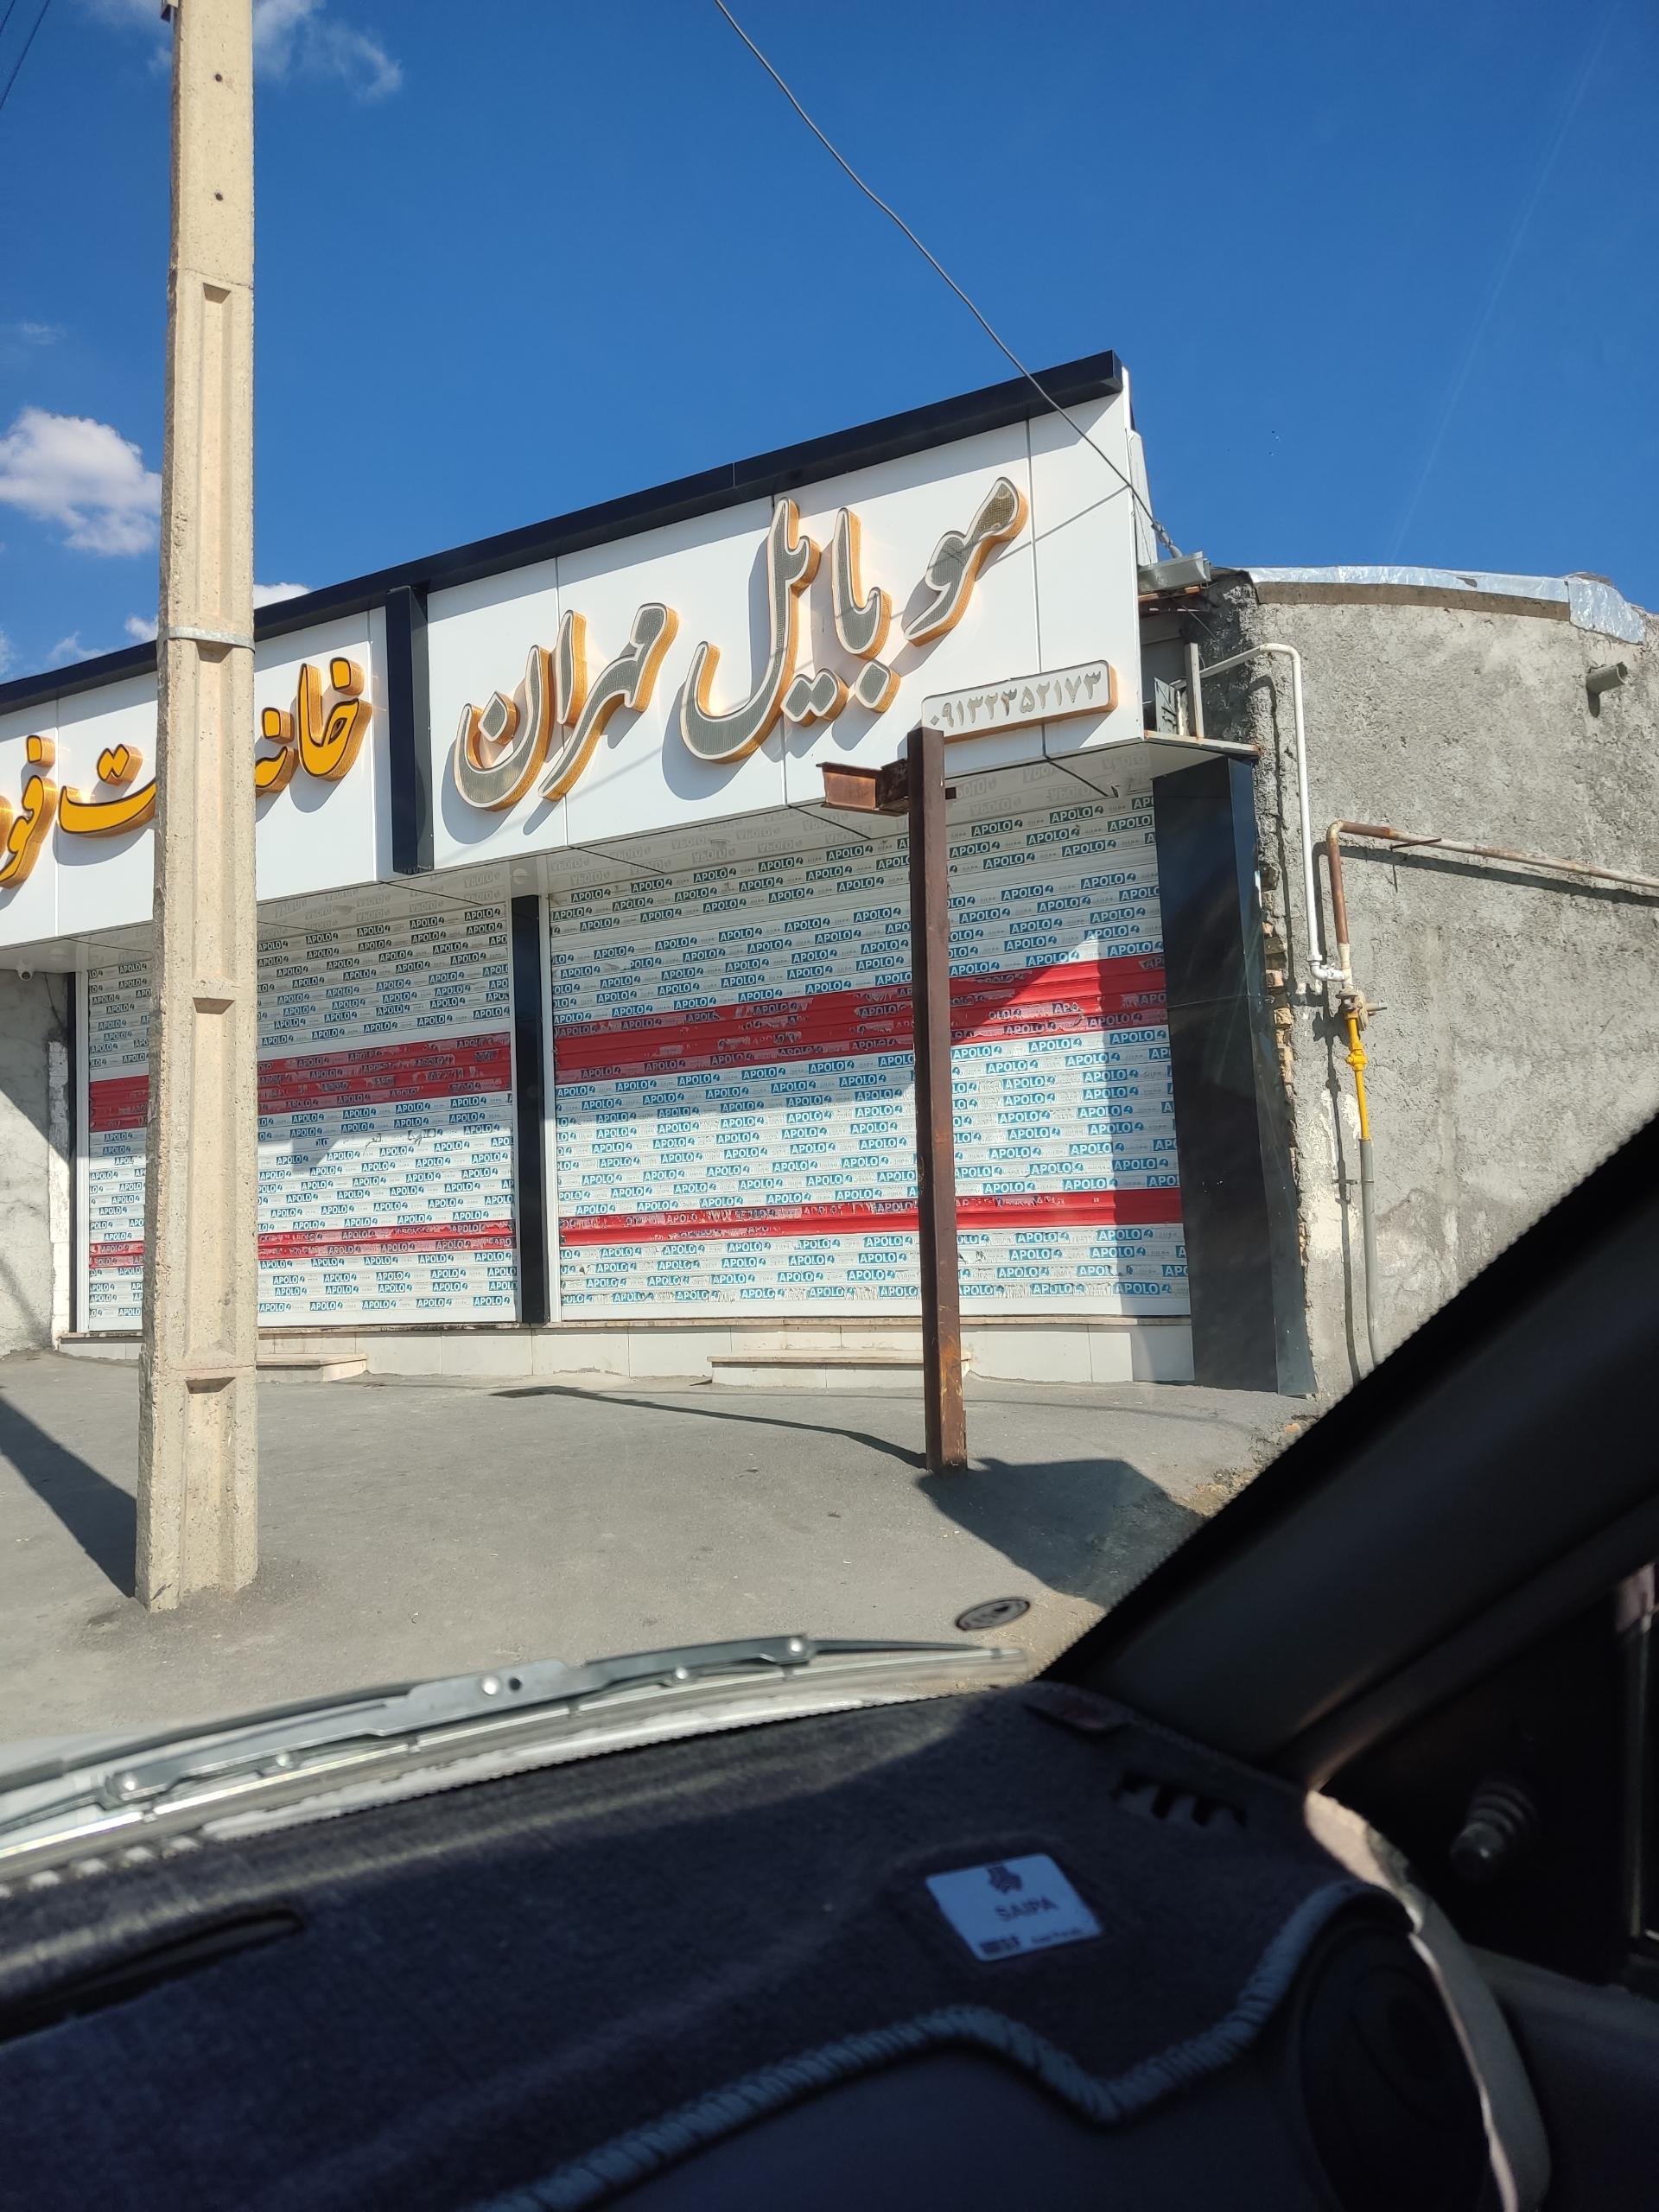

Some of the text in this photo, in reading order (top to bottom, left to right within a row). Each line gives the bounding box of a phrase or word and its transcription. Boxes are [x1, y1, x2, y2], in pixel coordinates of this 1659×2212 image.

[454, 477, 1028, 810] موبایل مهران
[929, 670, 1102, 728] ۰۹۱۳۲۳۵۲۱۷۳
[572, 806, 1092, 902] APOLO APOLO APOLO APOLO APOLO APOLO APOLO
[613, 898, 644, 911] APOLO
[675, 887, 708, 901] APOLO
[740, 877, 773, 891] APOLO
[806, 866, 842, 880] APOLO
[950, 842, 989, 857] APOLO
[1027, 829, 1068, 844] APOLO
[581, 840, 1105, 931] APOLO APOLO APOLO APOLO APOLO APOLO APOLO
[306, 908, 493, 944] APOLO APOLO APOLO APOLO
[594, 873, 1124, 958] APOLO APOLO APOLO APOLO APOLO APOLO APOLO
[307, 923, 494, 959] APOLO APOLO APOLO APOLO
[561, 897, 1079, 978] APOLO APOLO APOLO APOLO APOLO APOLO
[601, 907, 1134, 988] APOLO APOLO APOLO APOLO APOLO APOLO APOLO
[292, 952, 478, 988] APOLO APOLO APOLO APOLO
[597, 925, 1128, 1003] APOLO APOLO APOLO APOLO APOLO APOLO APOLO
[613, 941, 1152, 1017] APOLO APOLO APOLO APOLO APOLO APOLO APOLO
[92, 994, 113, 1005] APOLO
[106, 1003, 128, 1014] APOLO
[283, 985, 462, 1016] APOLO APOLO APOLO APOLO
[99, 1020, 120, 1030] APOLO
[104, 1031, 125, 1041] APOLO
[262, 1007, 501, 1046] APOLO APOLO APOLO APOLO APOLO
[123, 1052, 144, 1063] APOLO
[616, 1080, 647, 1091] APOLO
[677, 1074, 711, 1085] APOLO
[742, 1067, 776, 1079] APOLO
[809, 1060, 844, 1073] APOLO
[1028, 1038, 1071, 1052] APOLO
[1109, 1030, 1154, 1044] APOLO
[582, 1052, 1109, 1109] APOLO APOLO APOLO APOLO APOLO APOLO APOLO
[290, 1112, 477, 1137] APOLO APOLO APOLO APOLO
[292, 1096, 479, 1122] APOLO APOLO APOLO APOLO
[596, 1086, 1127, 1138] APOLO APOLO APOLO APOLO APOLO APOLO APOLO
[103, 1145, 124, 1155] APOLO
[105, 1132, 126, 1141] APOLO
[600, 1122, 1132, 1167] APOLO APOLO APOLO APOLO APOLO APOLO APOLO
[119, 1182, 142, 1191] APOLO
[611, 1158, 1157, 1197] APOLO APOLO APOLO APOLO APOLO APOLO APOLO
[111, 1195, 133, 1204] APOLO
[364, 1256, 391, 1265] APOLO
[418, 1254, 446, 1263] APOLO
[475, 1252, 503, 1261] APOLO
[596, 1246, 1134, 1272] APOLO APOLO APOLO APOLO APOLO APOLO APOLO
[310, 1296, 502, 1310] APOLO APOLO APOLO APOLO
